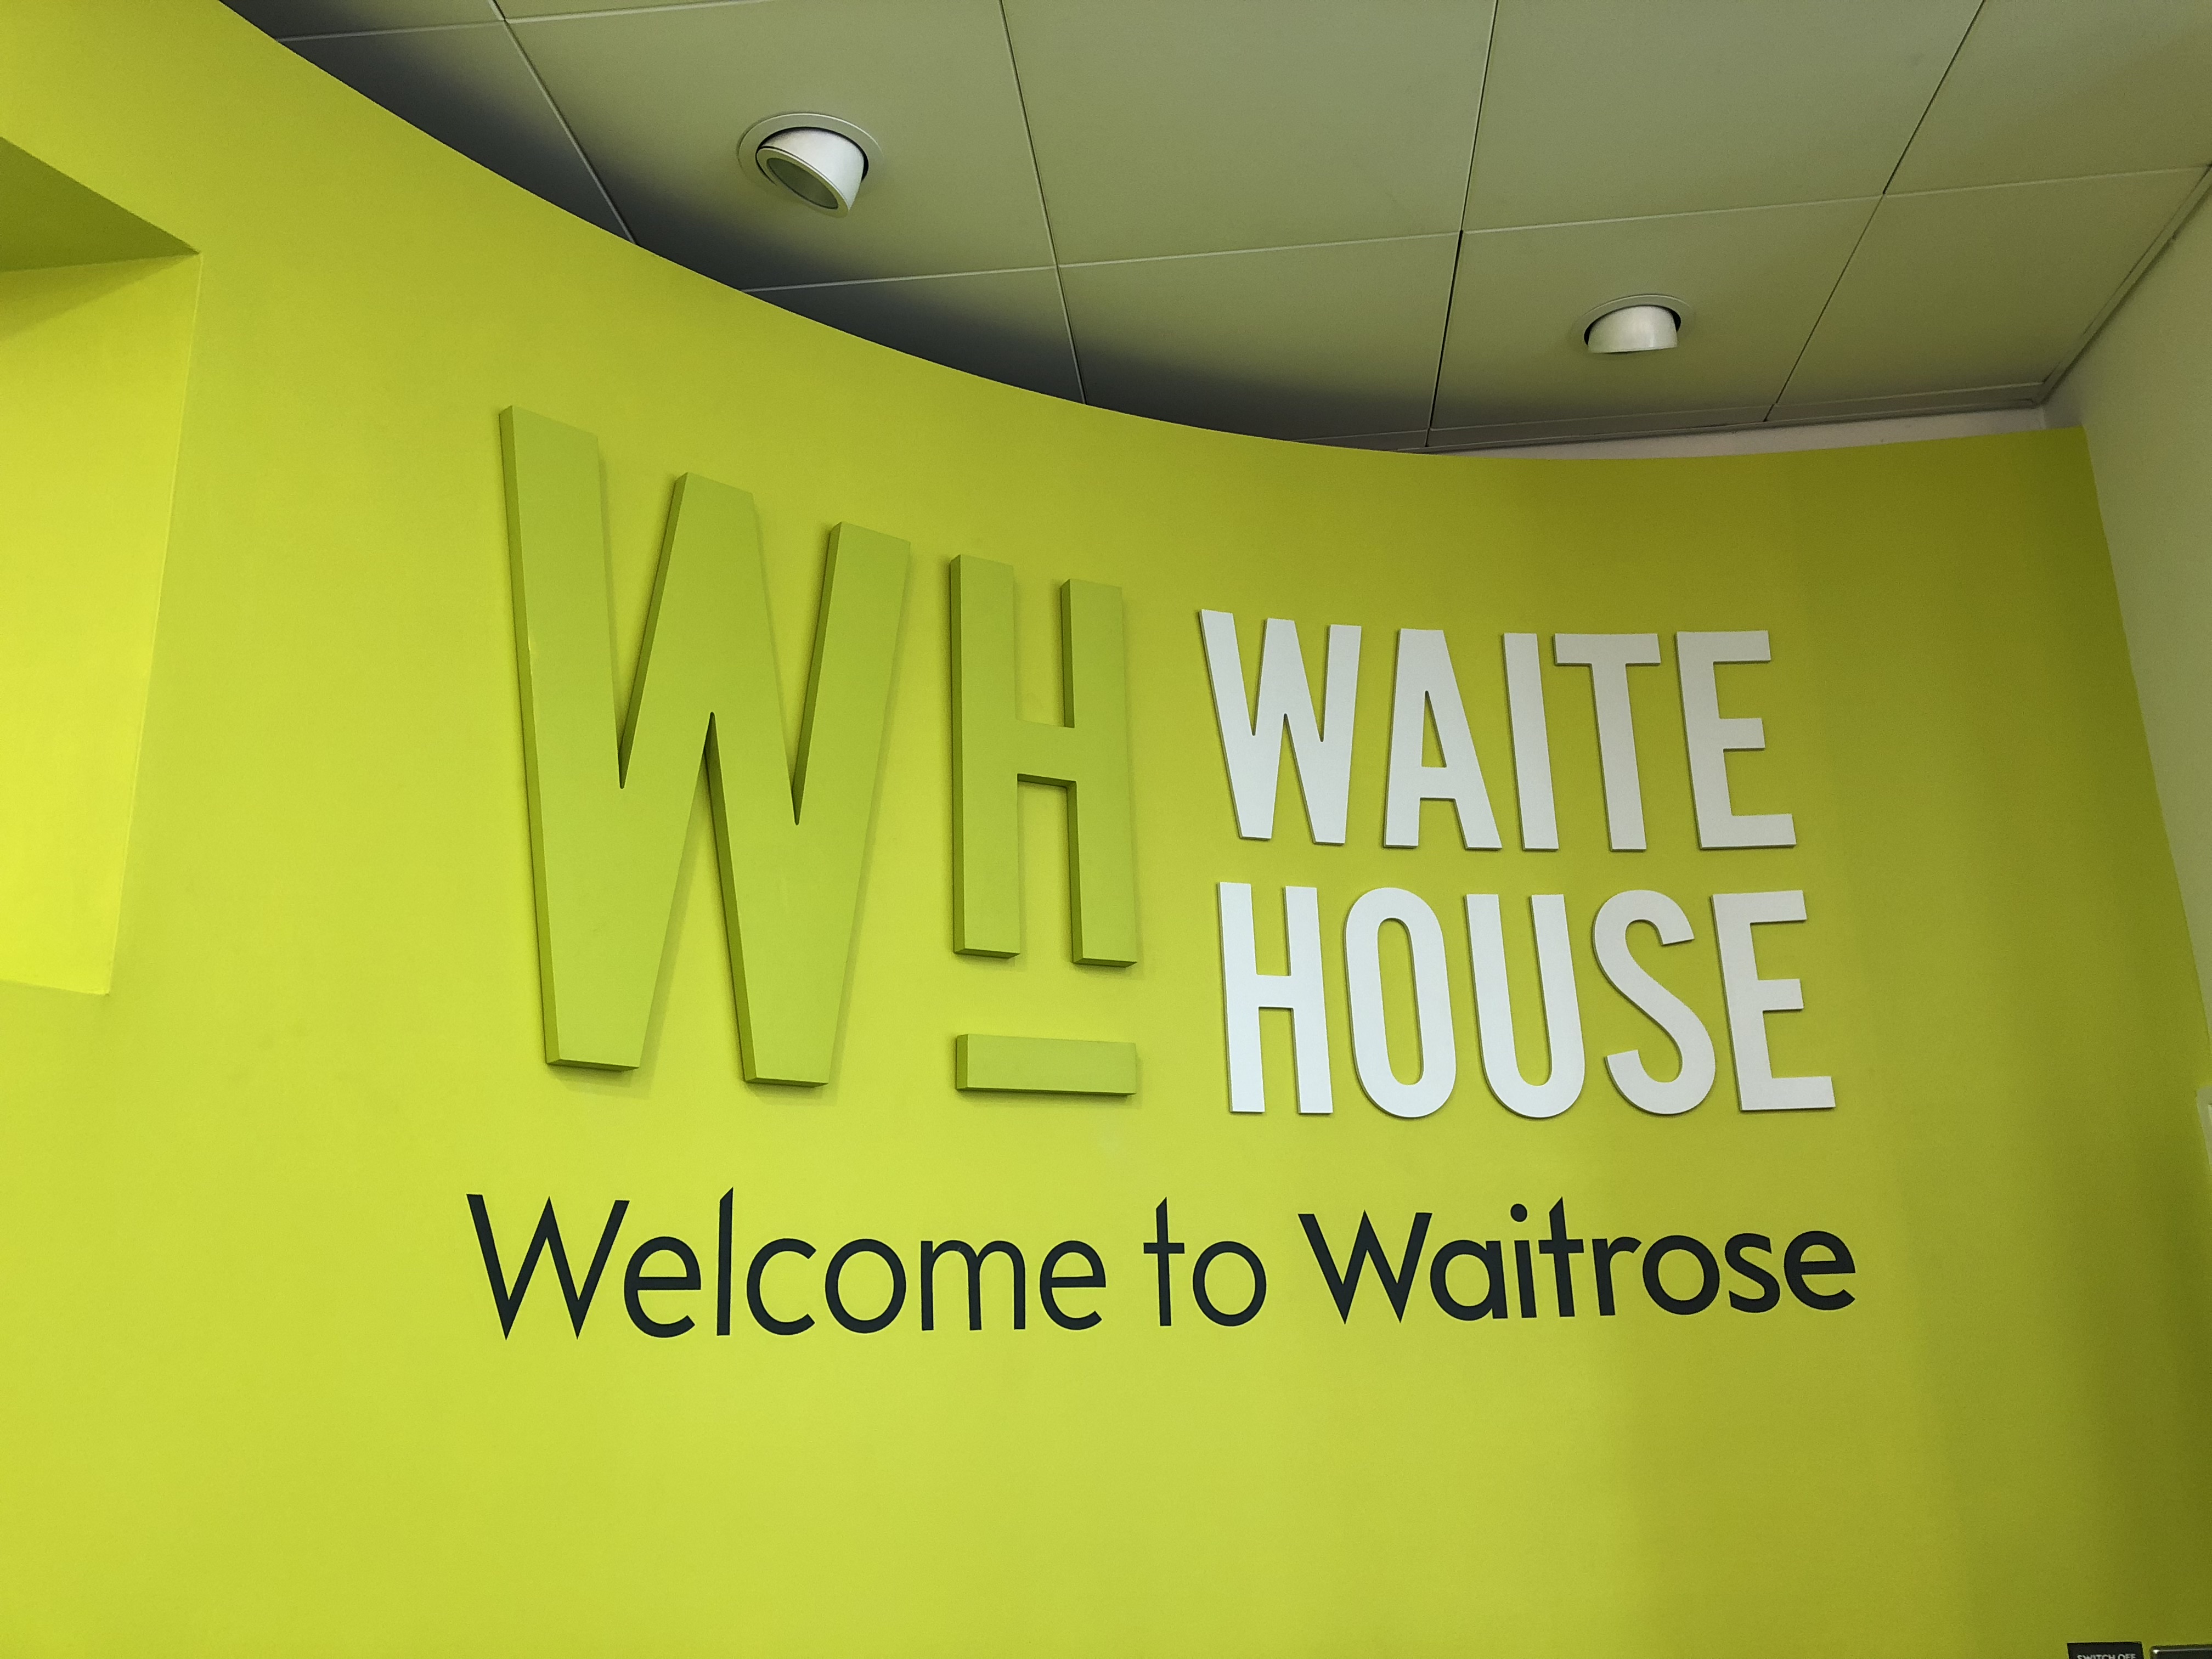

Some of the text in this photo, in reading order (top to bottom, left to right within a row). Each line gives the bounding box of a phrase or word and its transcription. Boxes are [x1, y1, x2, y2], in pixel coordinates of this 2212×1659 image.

[499, 405, 1137, 1088] WH
[1199, 609, 1797, 851] WAITE
[1217, 882, 1836, 1120] HOUSE
[466, 1187, 1856, 1340] Welcome to Waitrose
